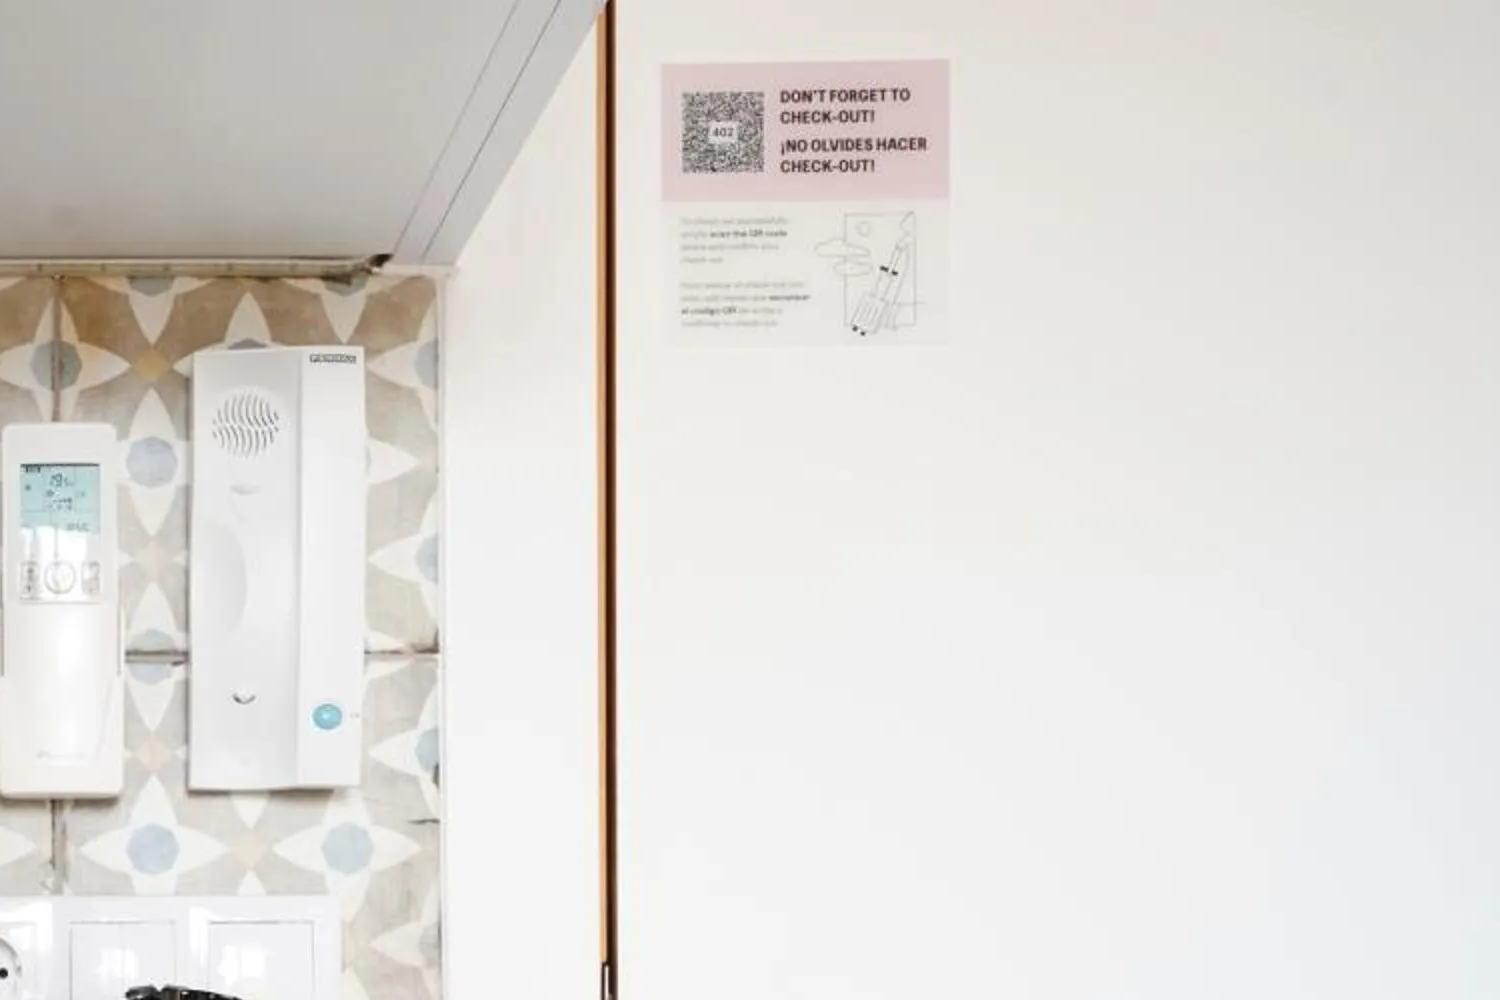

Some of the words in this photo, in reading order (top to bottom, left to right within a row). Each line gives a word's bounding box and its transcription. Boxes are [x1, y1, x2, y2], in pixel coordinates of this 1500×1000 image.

[780, 88, 827, 104] DON'T
[829, 88, 888, 103] FORGET
[890, 87, 911, 102] TO
[780, 109, 875, 125] CHECK-OUT!
[712, 127, 735, 138] 402
[780, 139, 808, 156] ¡NO
[810, 137, 874, 153] OLVIDES
[875, 136, 927, 151] HACER
[780, 158, 875, 174] CHECK-OUT!
